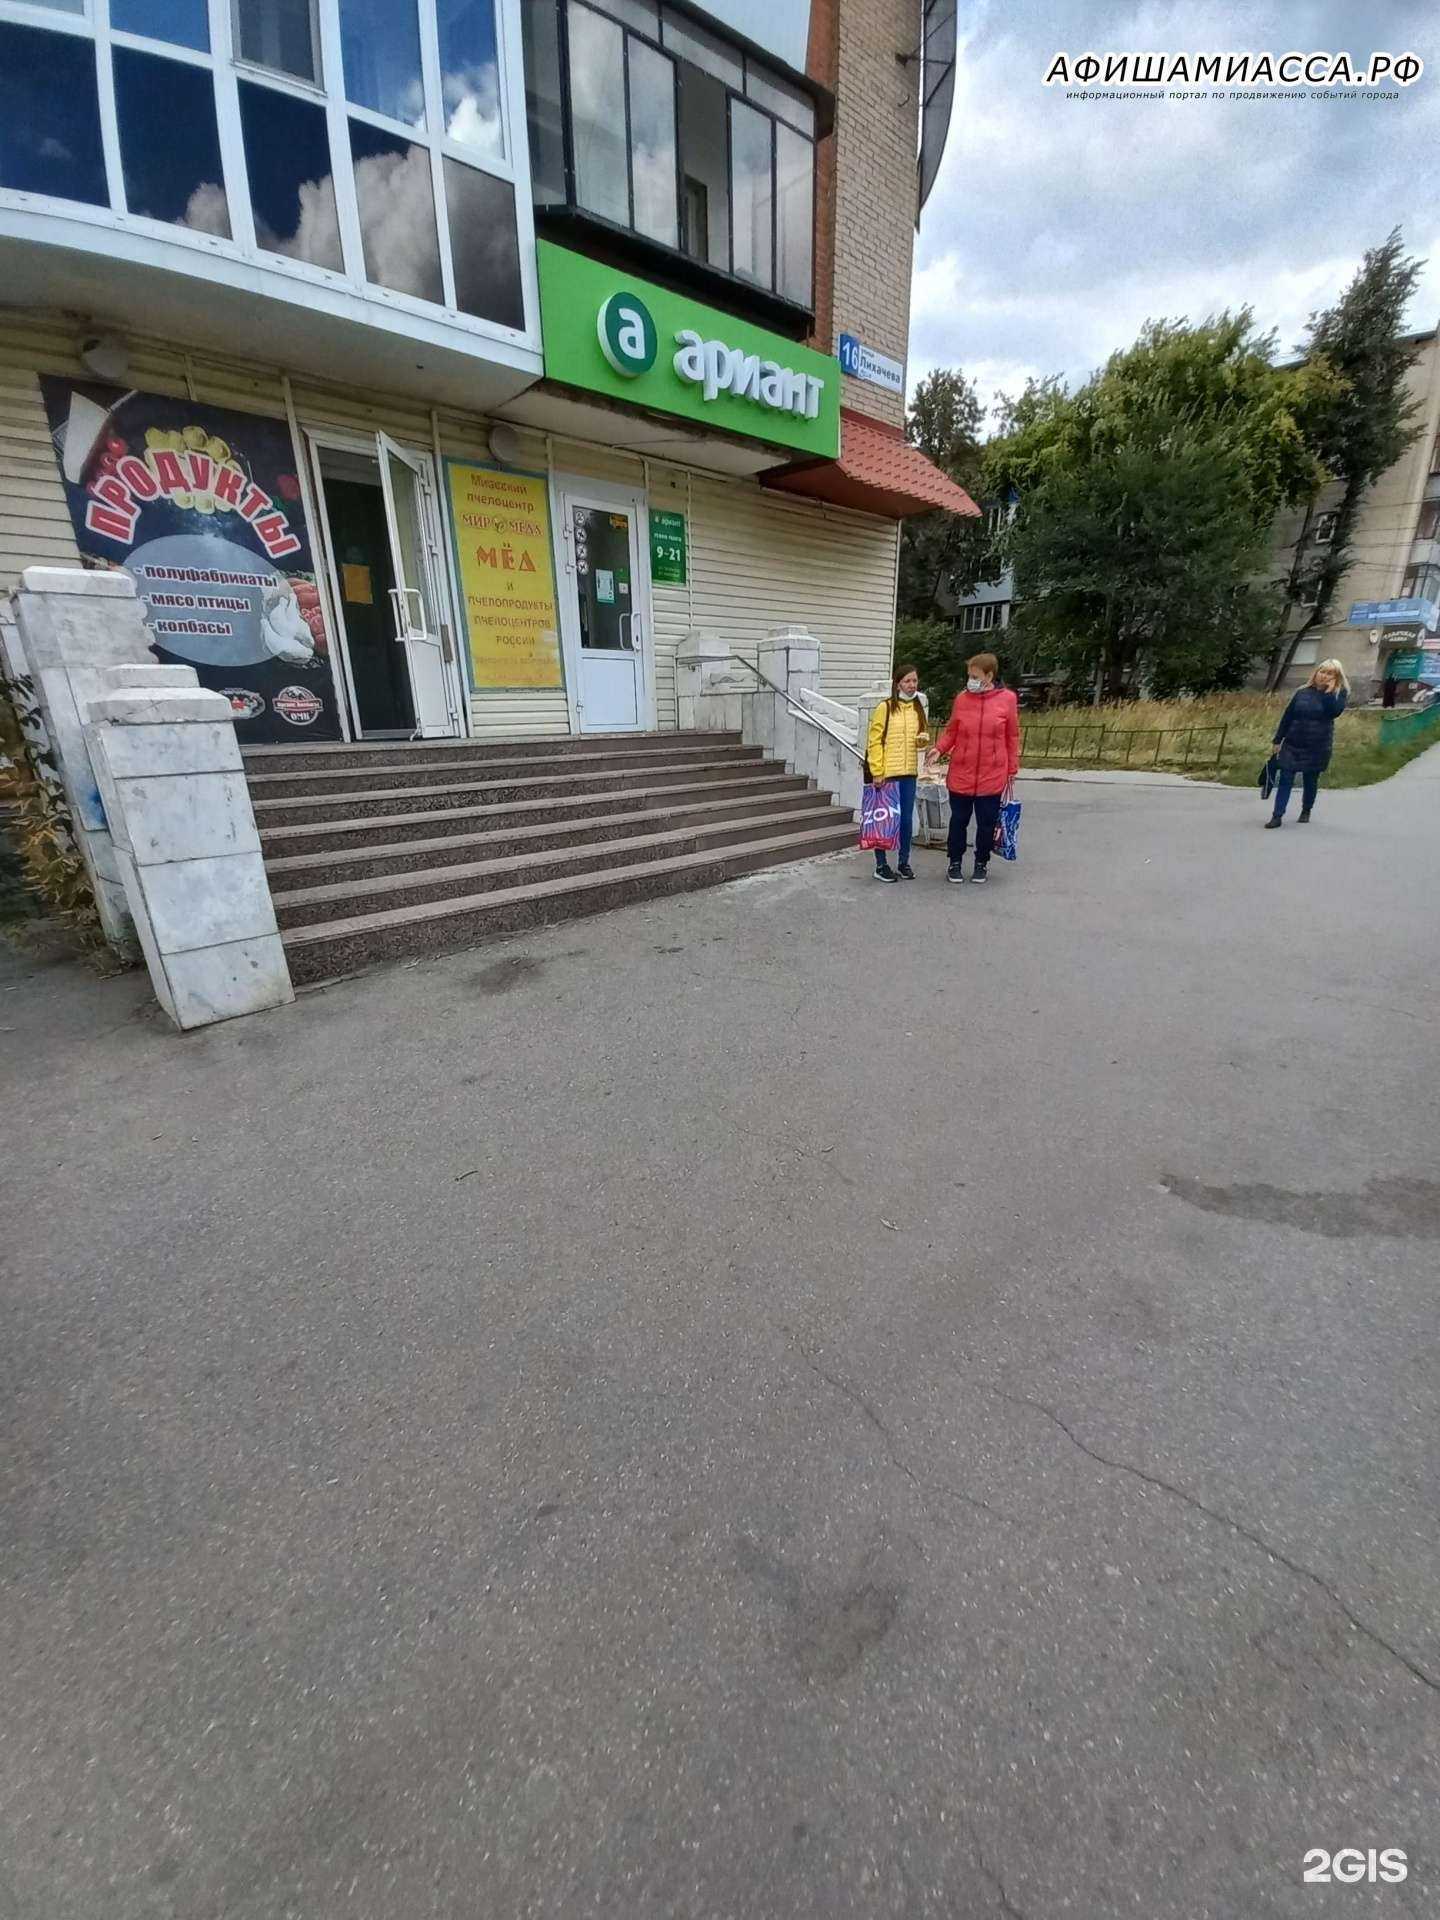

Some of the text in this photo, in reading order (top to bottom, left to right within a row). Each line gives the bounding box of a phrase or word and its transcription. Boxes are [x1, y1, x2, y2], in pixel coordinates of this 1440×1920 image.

[842, 341, 858, 370] 16
[672, 329, 824, 420] ариант
[860, 356, 901, 384] Лихачева
[470, 473, 528, 495] Миасский
[86, 449, 301, 559] ПРОДУКТЫ
[466, 493, 534, 514] пчелоцентр
[476, 541, 537, 573] МЁД
[143, 565, 279, 588] полуфабрикаты
[150, 593, 251, 612] мясо птицы
[468, 595, 553, 611] ПЧЕЛОПРОДУКТЫ
[156, 619, 232, 635] колбасы
[474, 615, 552, 629] ПЧЕЛОЦЕНТРОВ
